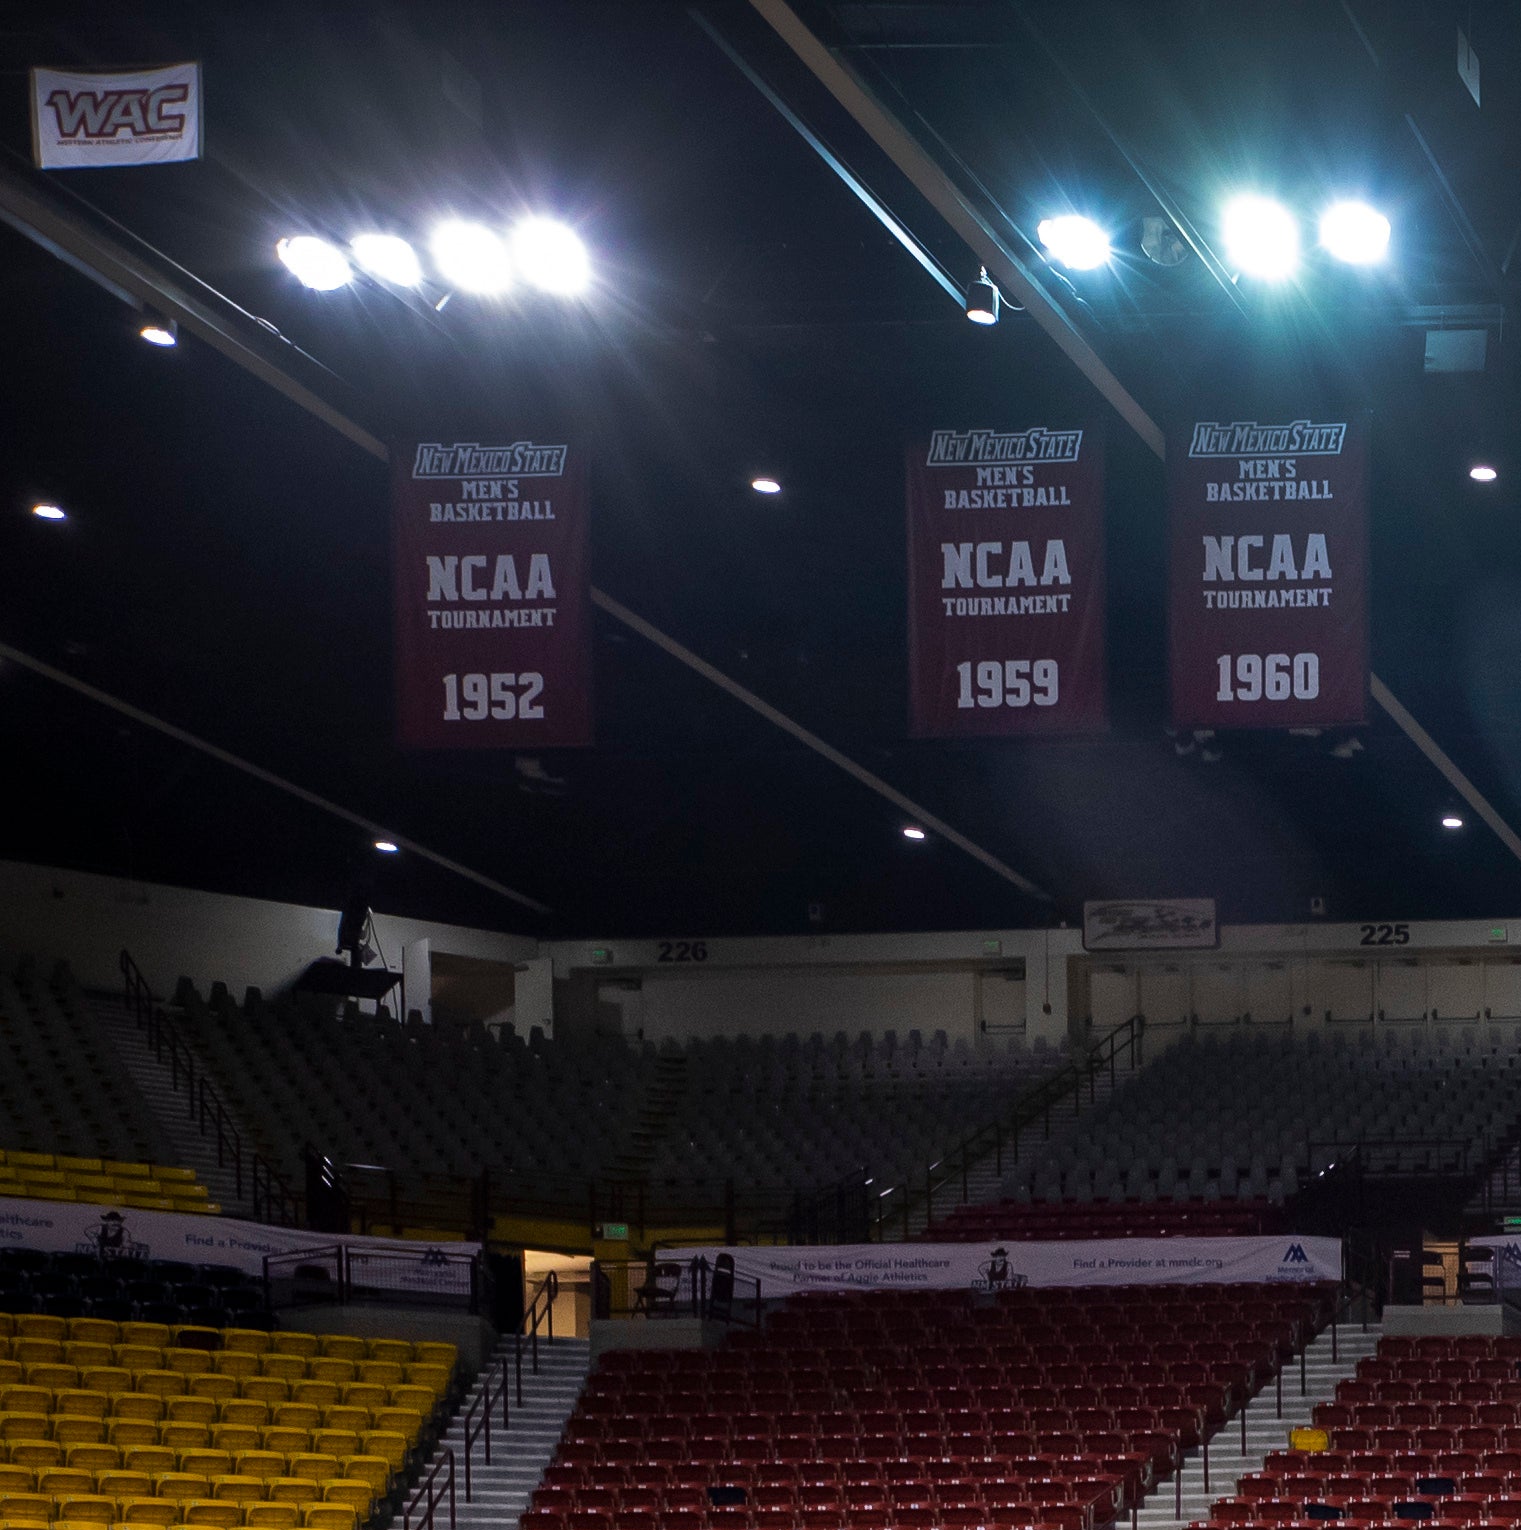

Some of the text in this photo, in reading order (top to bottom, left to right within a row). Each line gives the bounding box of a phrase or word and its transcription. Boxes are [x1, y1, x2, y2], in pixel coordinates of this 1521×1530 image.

[45, 83, 189, 138] WAC
[977, 466, 1034, 486] MEN'S
[1239, 460, 1296, 478] MEN'S
[463, 480, 518, 499] MEN'S
[945, 486, 1070, 509] BASKETBALL
[1206, 480, 1333, 501] BASKETBALL
[430, 501, 555, 522] BASKETBALL
[942, 539, 1071, 588] NCAA
[1202, 534, 1332, 581] NCAA
[426, 554, 556, 601] NCAA
[942, 595, 1071, 616] TOURNAMENT
[1203, 589, 1332, 608] TOURNAMENT
[428, 609, 556, 629] TOURNAMENT
[957, 660, 1059, 709] 1959
[1216, 653, 1319, 702] 1960
[443, 672, 544, 720] 1952
[1359, 924, 1410, 946] 225
[657, 941, 708, 962] 226
